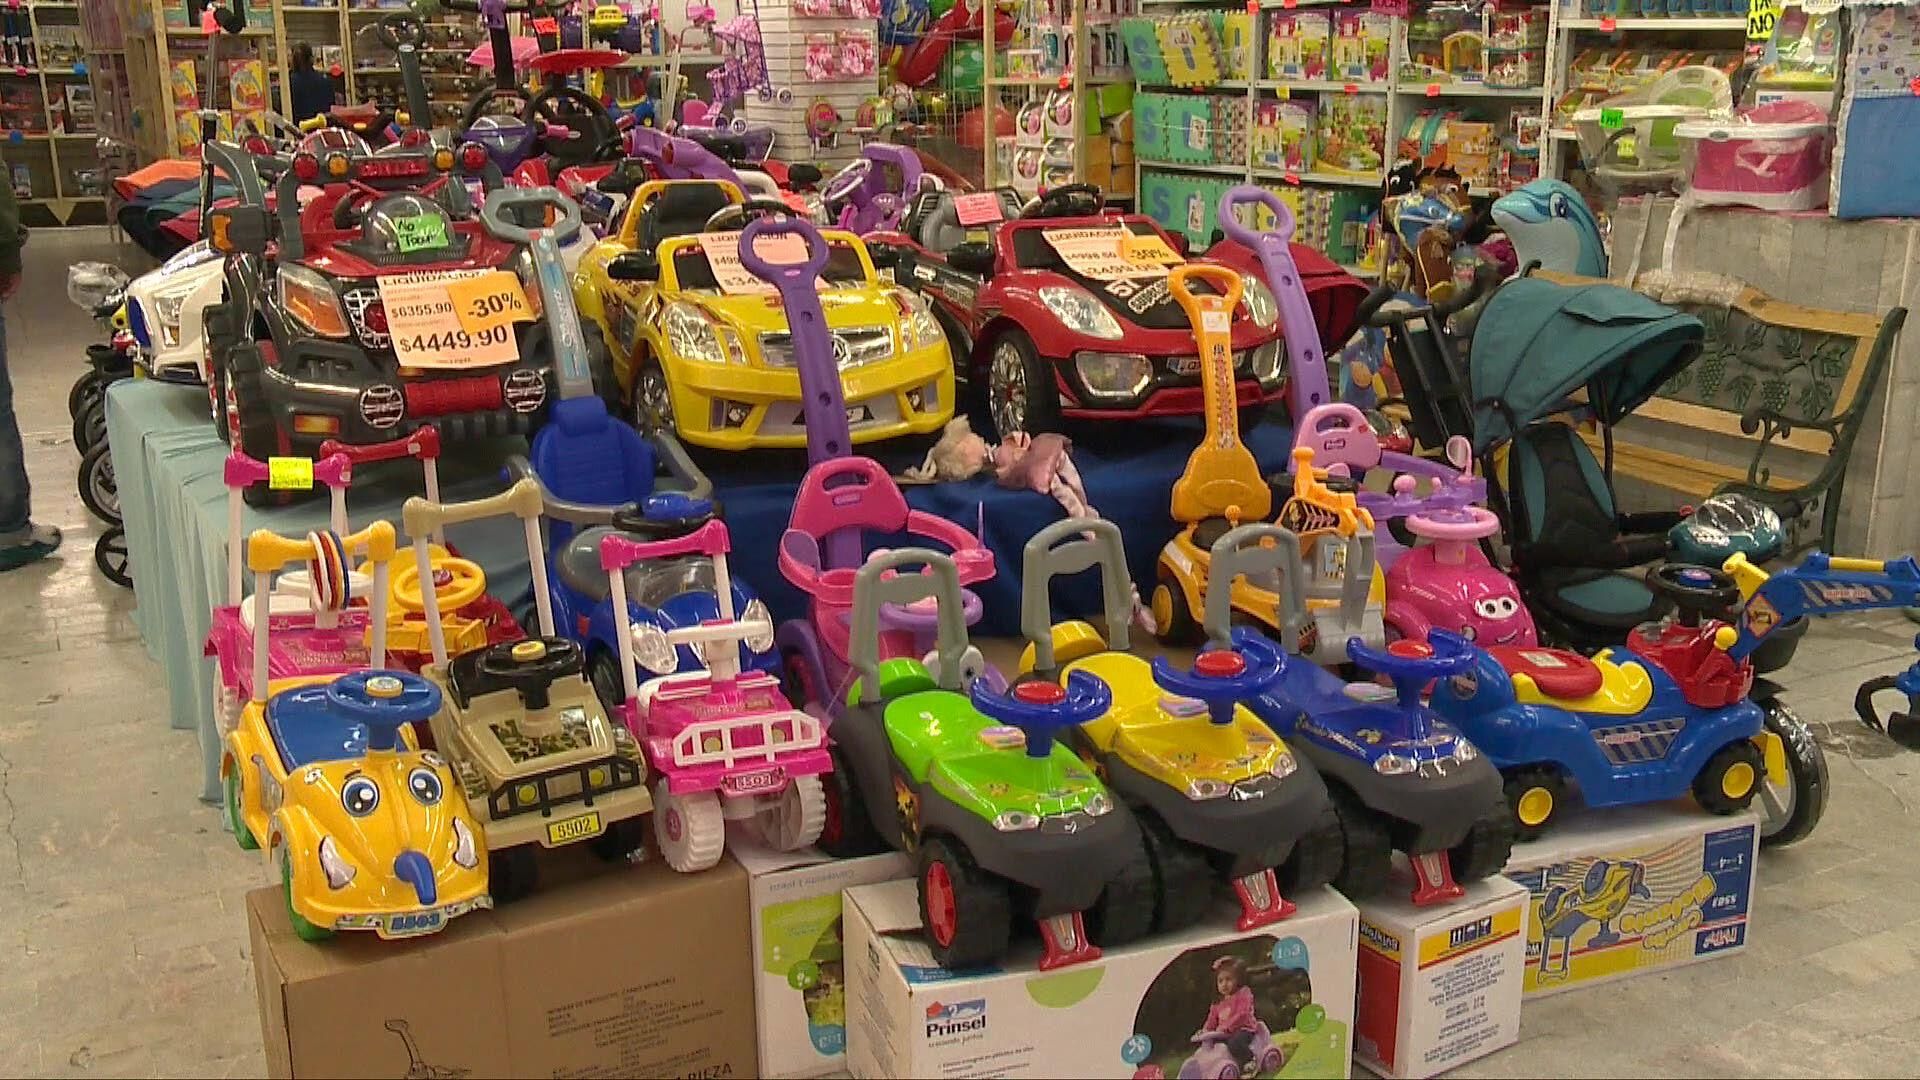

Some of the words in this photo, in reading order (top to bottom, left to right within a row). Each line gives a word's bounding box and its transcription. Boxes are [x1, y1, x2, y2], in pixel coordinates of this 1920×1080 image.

[1749, 12, 1775, 34] NO
[391, 301, 452, 319] $6355.90
[467, 291, 522, 318] -30%
[399, 324, 508, 353] $4449.90
[926, 1015, 986, 1038] Prinsel
